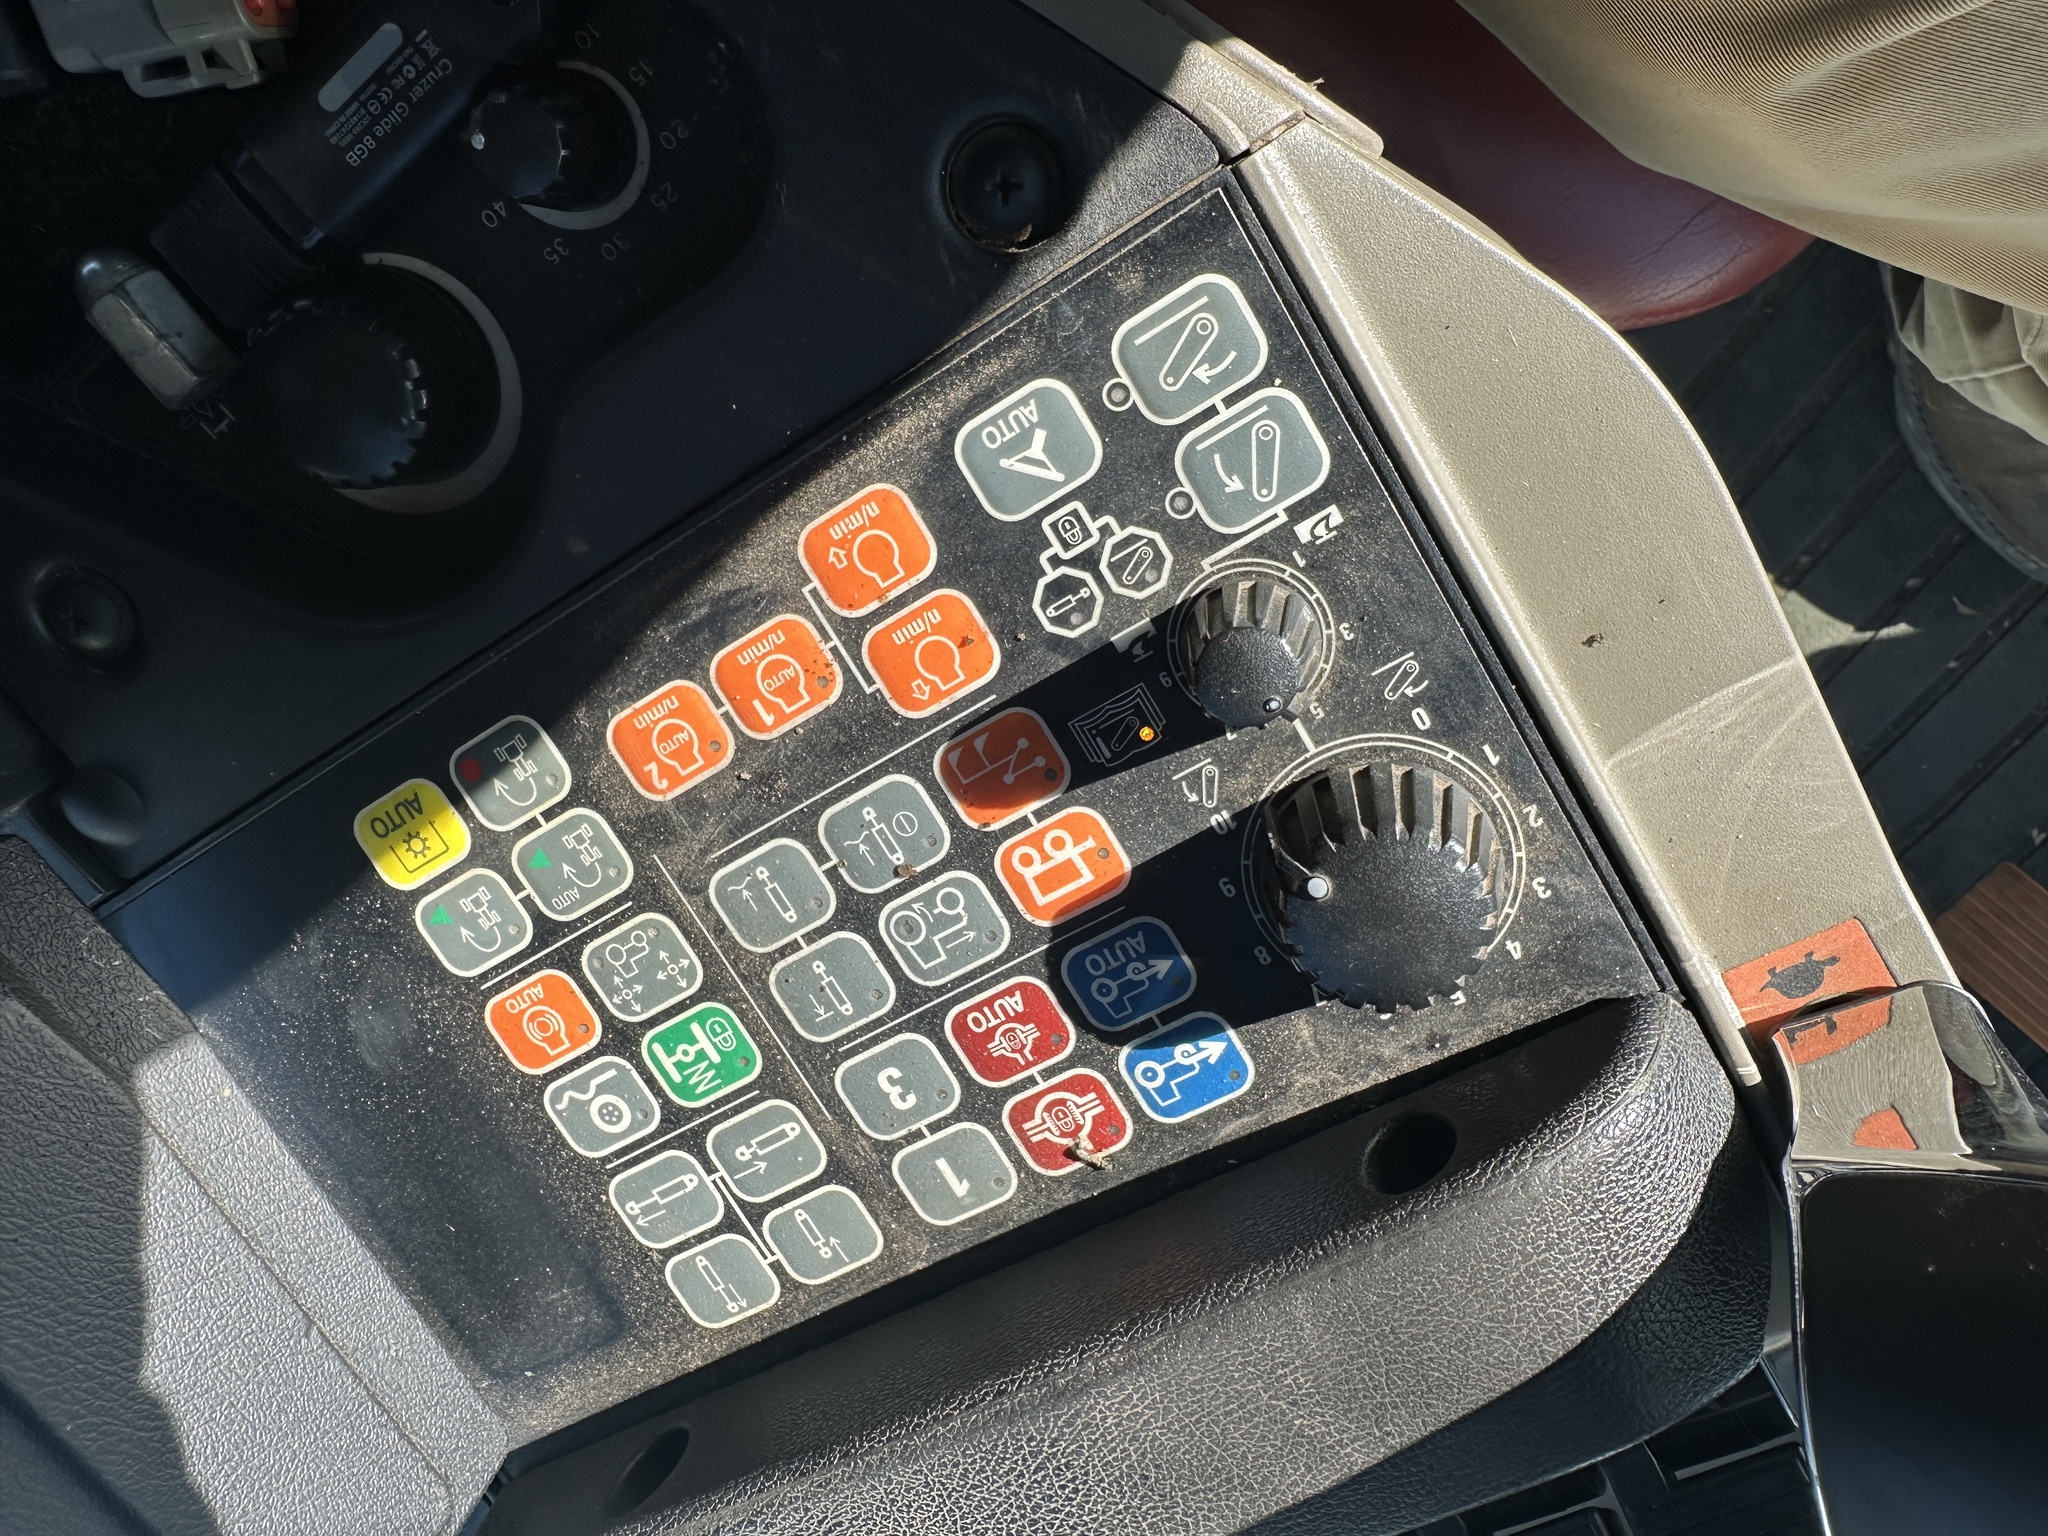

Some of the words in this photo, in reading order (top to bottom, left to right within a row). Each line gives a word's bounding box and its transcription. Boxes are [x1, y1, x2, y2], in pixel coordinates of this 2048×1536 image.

[574, 21, 600, 50] 10
[408, 58, 453, 104] Cruzer
[628, 60, 653, 87] 15
[372, 101, 410, 137] Glide
[659, 119, 689, 149] 20
[345, 135, 377, 167] 8GB
[651, 182, 679, 212] 25
[481, 201, 507, 228] 40
[543, 238, 570, 265] 35
[601, 232, 629, 260] 30
[981, 398, 1039, 449] AUTO
[828, 501, 881, 540] n/min
[1292, 550, 1307, 568] 1
[891, 608, 942, 645] n/min
[1338, 622, 1355, 641] 3
[736, 629, 786, 666] n/min
[763, 664, 796, 691] AUTO
[633, 695, 680, 730] n/min
[752, 698, 775, 727] 1
[1309, 701, 1326, 720] 5
[1411, 707, 1431, 731] 0
[659, 730, 691, 755] AUTO
[1482, 744, 1500, 766] 1
[643, 762, 669, 790] 2
[370, 792, 424, 839] AUTO
[1210, 810, 1238, 836] 10
[1522, 804, 1543, 828] 2
[551, 886, 581, 911] AUTO
[1218, 877, 1237, 898] 9
[1532, 877, 1551, 900] 3
[1084, 930, 1146, 977] AUTO
[1253, 945, 1272, 966] 8
[1505, 940, 1522, 960] 4
[505, 982, 545, 1014] AUTO
[966, 990, 1025, 1034] AUTO
[876, 1066, 917, 1110] 3
[934, 1157, 971, 1198] 1
